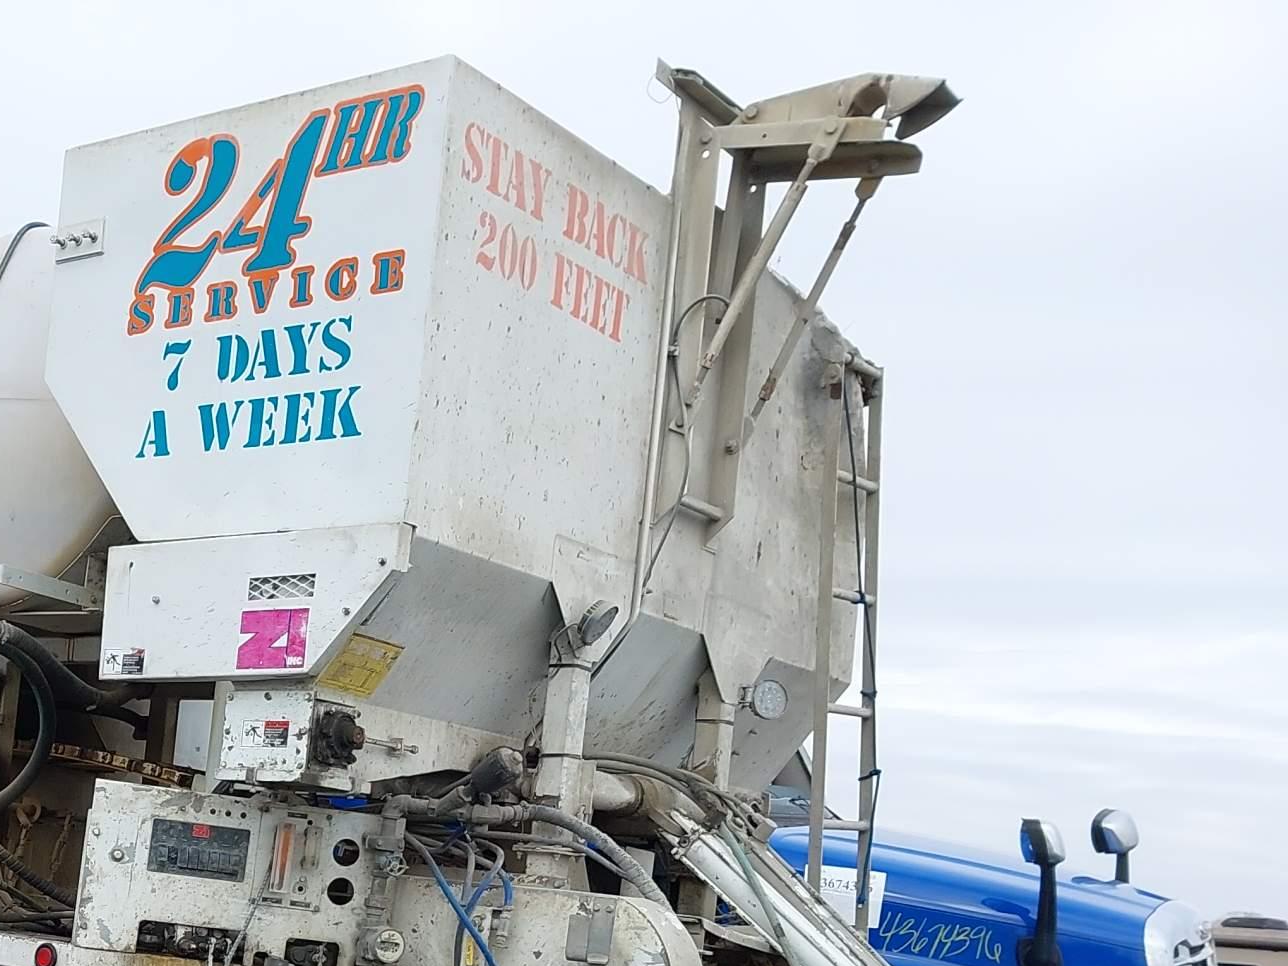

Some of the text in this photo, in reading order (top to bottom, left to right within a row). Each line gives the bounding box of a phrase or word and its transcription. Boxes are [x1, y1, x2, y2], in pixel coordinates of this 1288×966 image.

[134, 84, 426, 296] 24 HR
[460, 120, 650, 286] STAY BACK
[126, 249, 406, 337] SERVICE
[476, 210, 632, 344] 200 FEET
[163, 314, 354, 392] 7 DAYS
[135, 384, 363, 460] A WEEK
[879, 911, 1002, 964] 43674396
